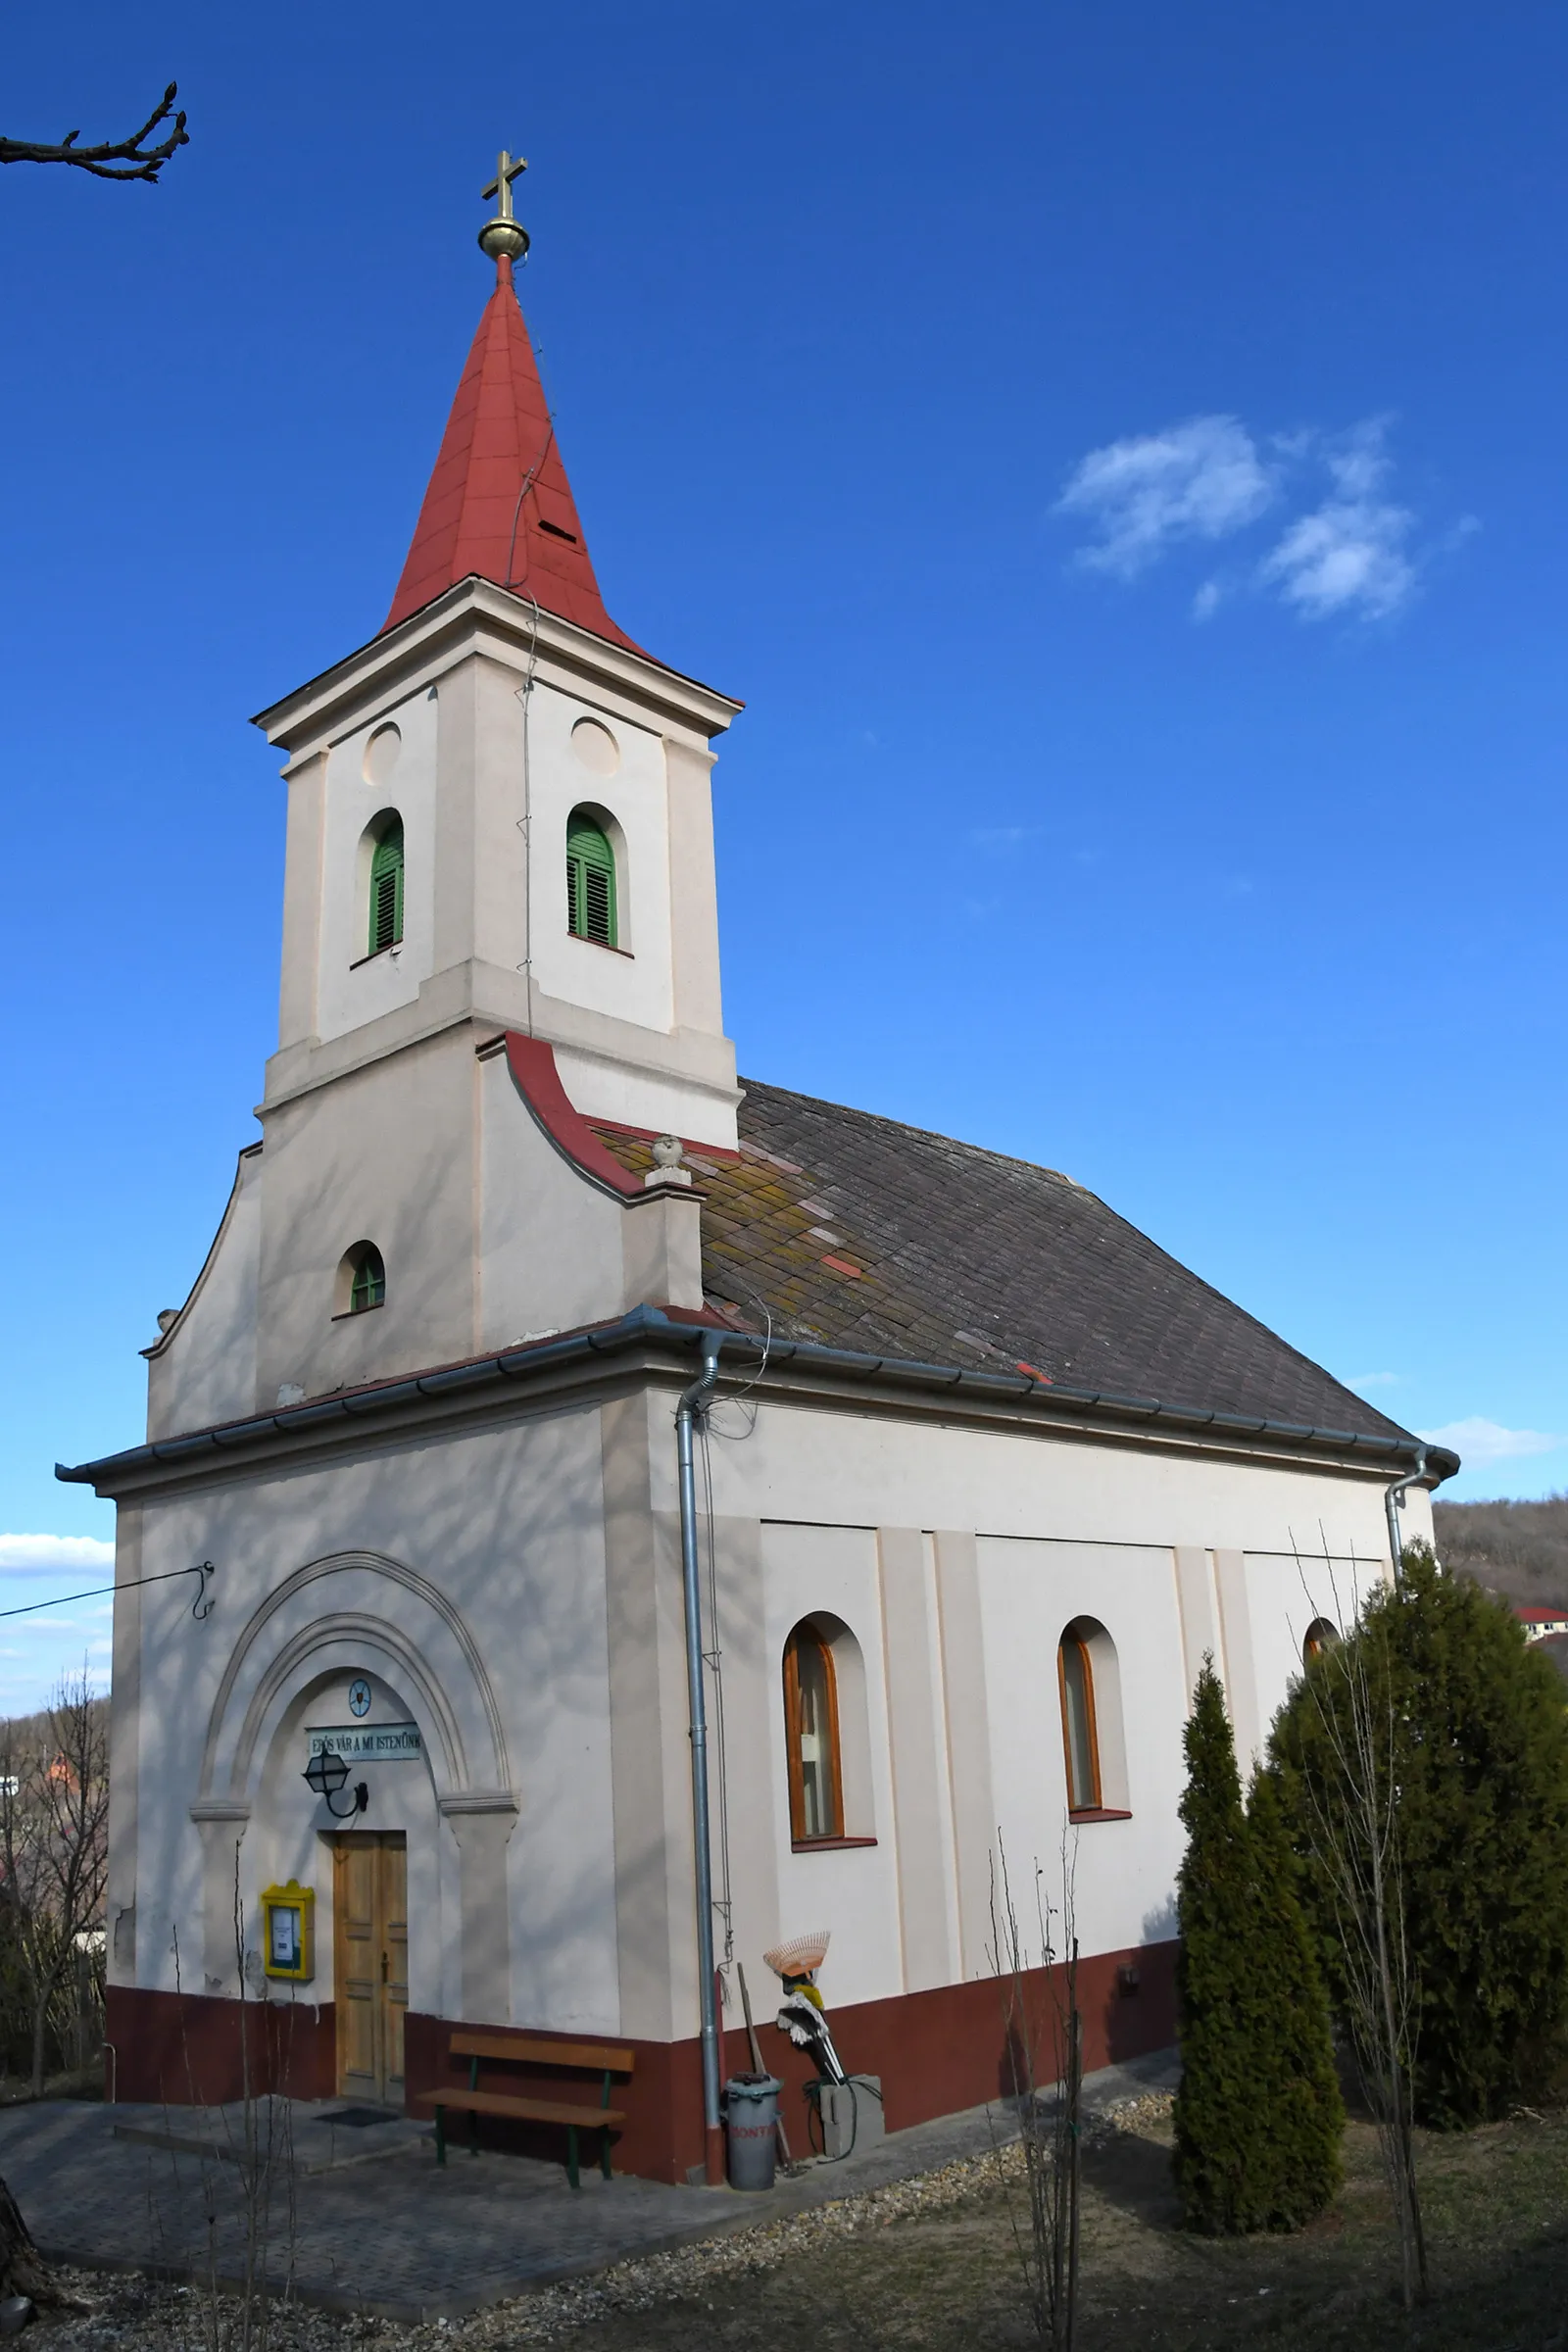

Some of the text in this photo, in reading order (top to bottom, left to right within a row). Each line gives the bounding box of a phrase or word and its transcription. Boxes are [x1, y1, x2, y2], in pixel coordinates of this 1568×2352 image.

[336, 1734, 352, 1751] VÁR
[354, 1736, 360, 1751] A
[363, 1736, 373, 1750] MI
